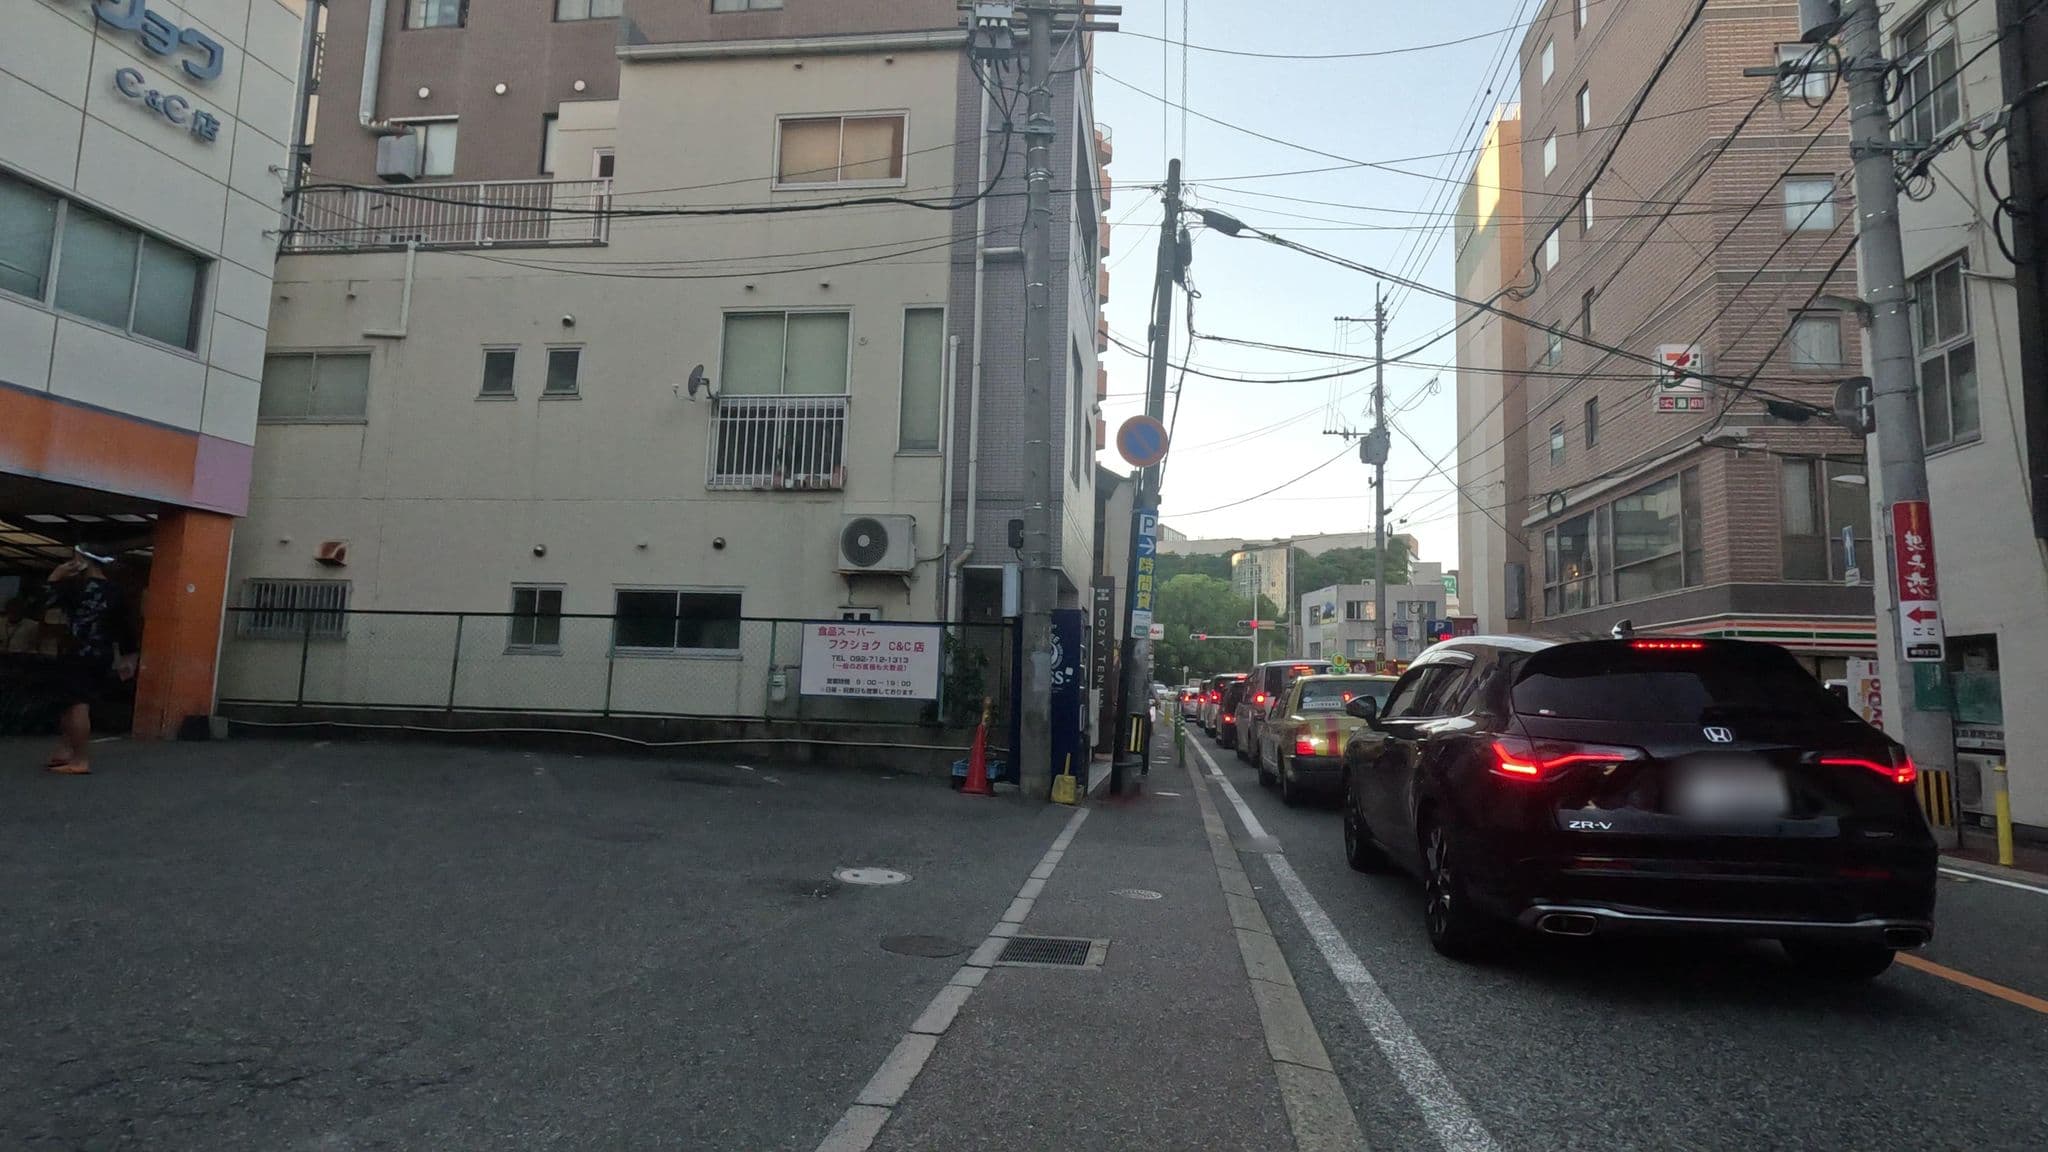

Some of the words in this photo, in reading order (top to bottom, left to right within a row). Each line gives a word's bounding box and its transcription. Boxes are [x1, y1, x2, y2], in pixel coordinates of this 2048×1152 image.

[1144, 516, 1155, 533] P
[1138, 557, 1153, 608] 時間貸
[818, 626, 876, 637] 食品スーパー
[1097, 607, 1108, 647] COZY
[1568, 820, 1613, 830] ZR-V
